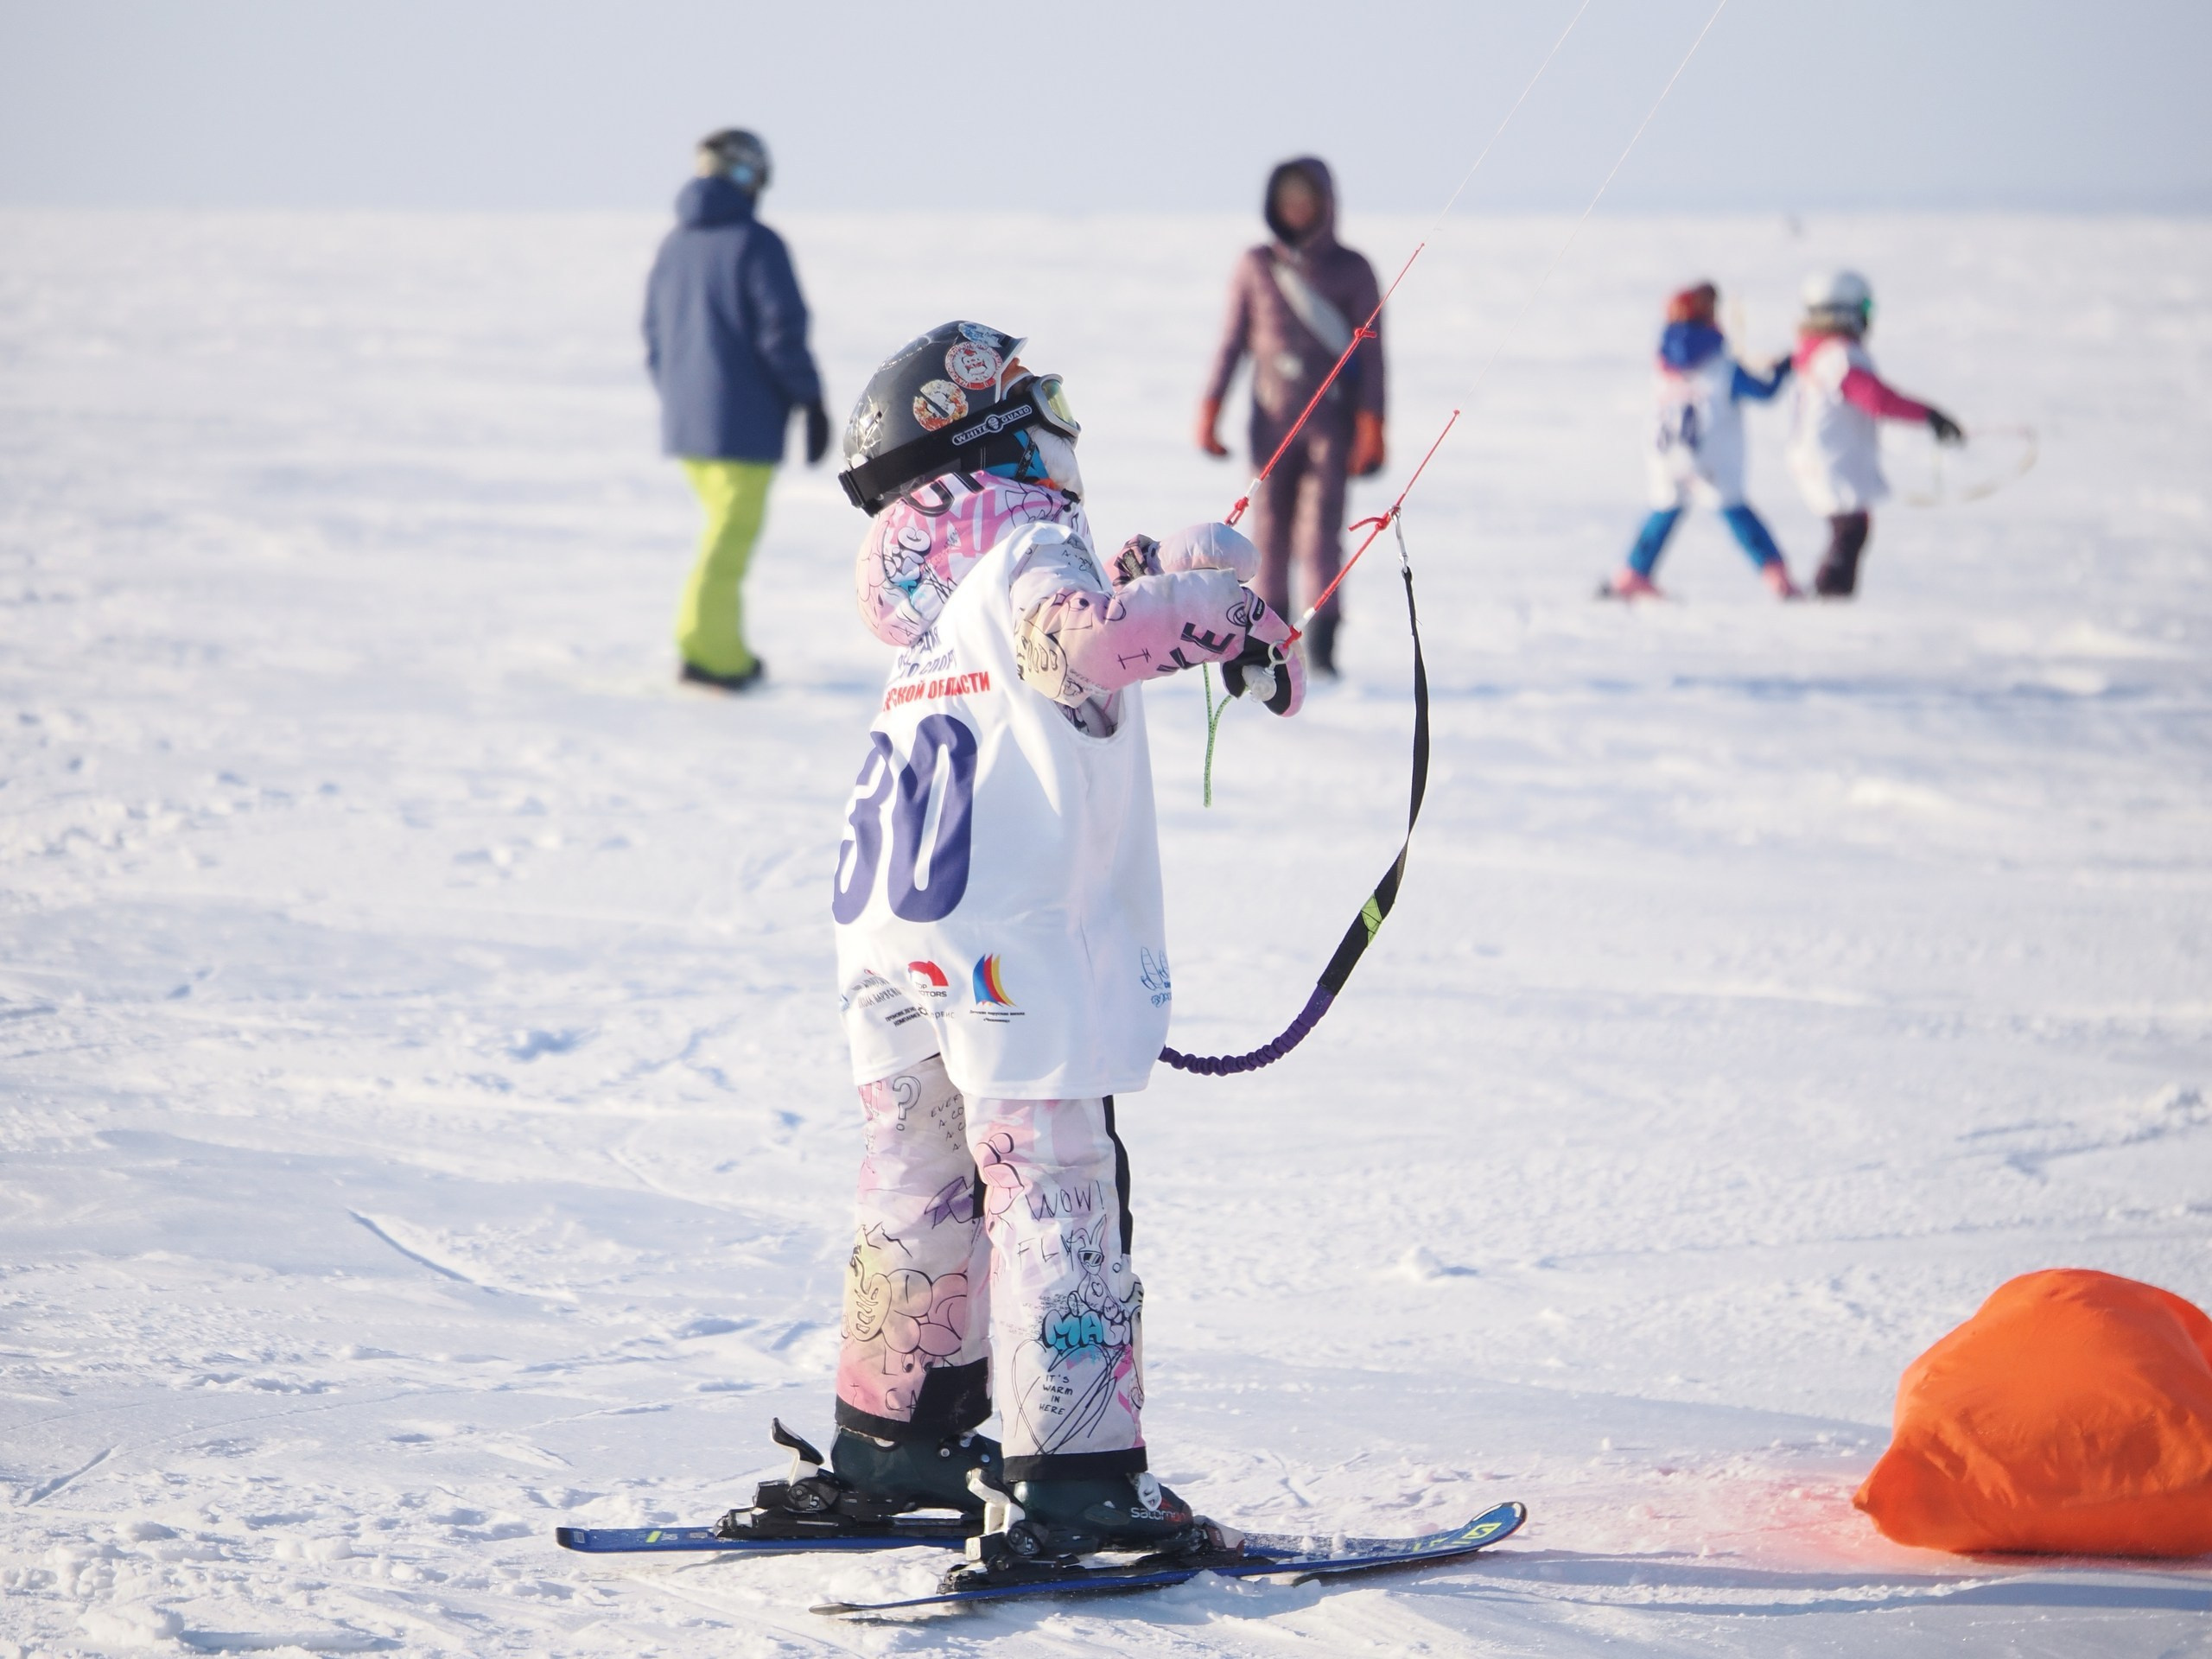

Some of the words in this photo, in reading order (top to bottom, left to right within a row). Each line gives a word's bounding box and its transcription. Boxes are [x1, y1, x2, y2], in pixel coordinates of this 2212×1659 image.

[956, 424, 988, 442] WHITE
[1001, 407, 1029, 423] GUARD
[1025, 1179, 1105, 1222] WOW!
[1042, 1383, 1074, 1395] WARM
[1039, 1404, 1066, 1415] HERE
